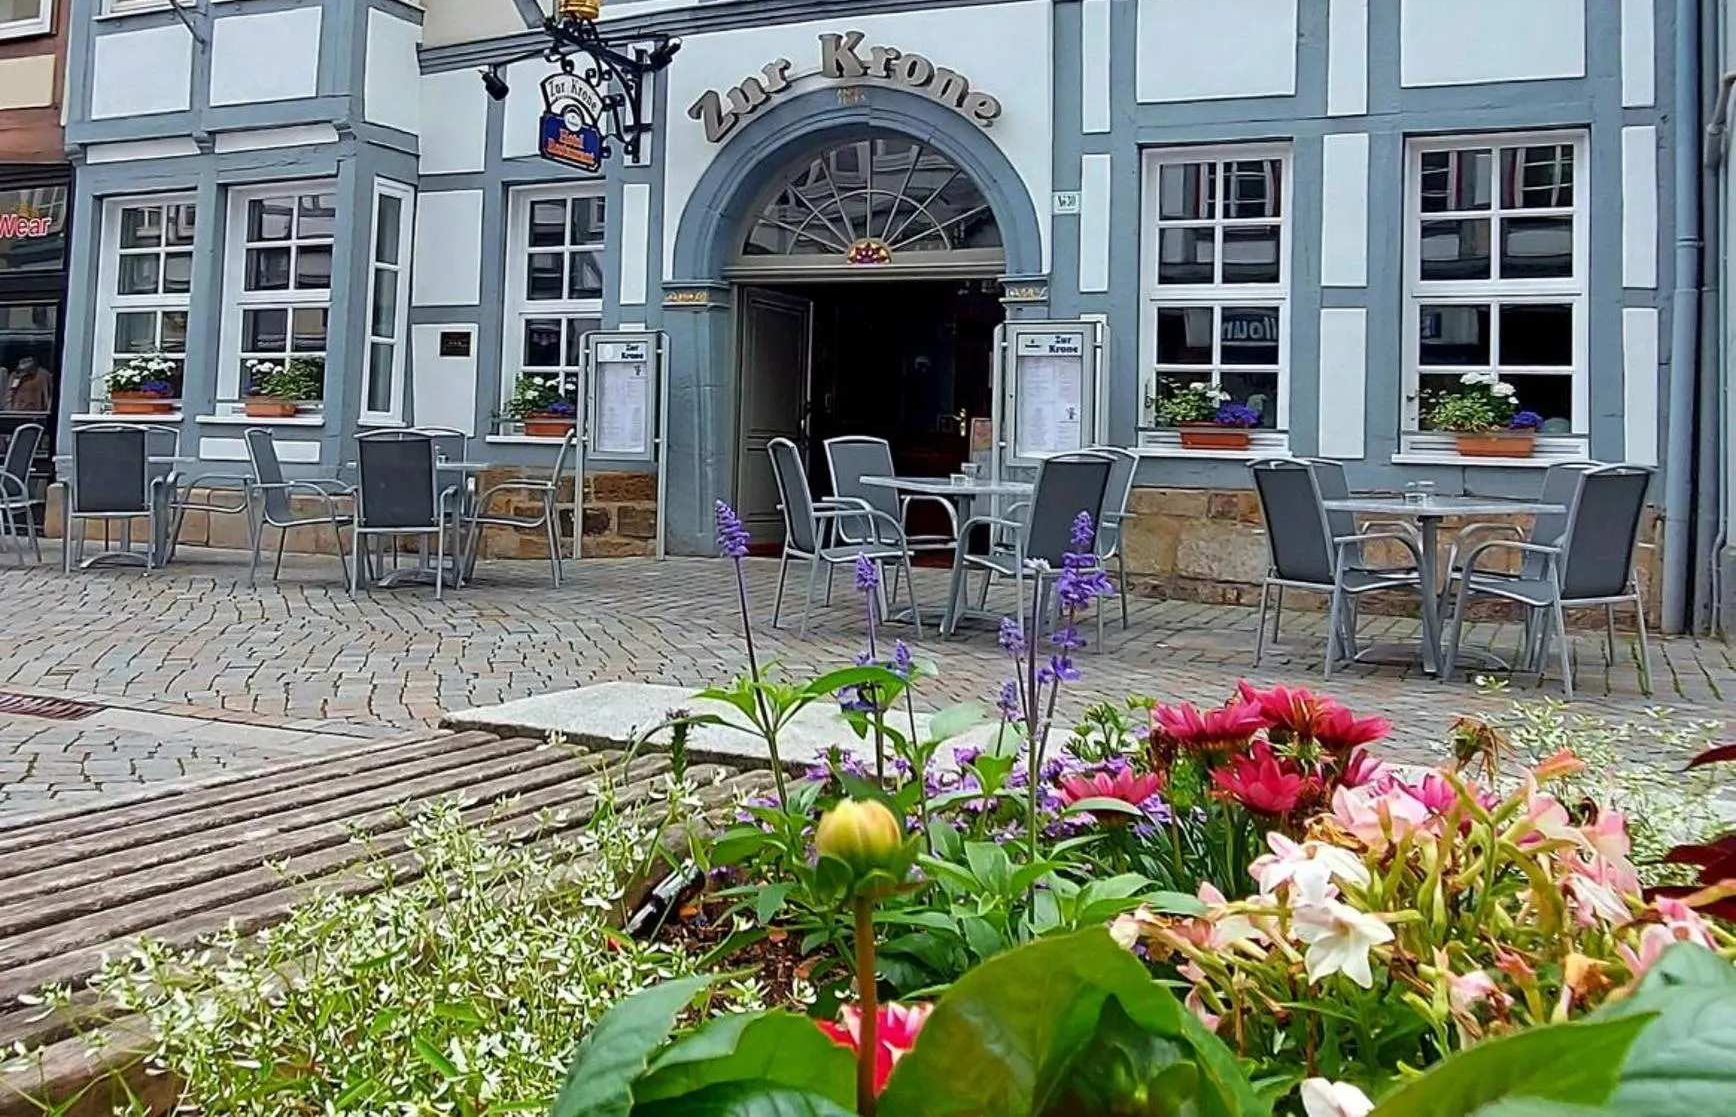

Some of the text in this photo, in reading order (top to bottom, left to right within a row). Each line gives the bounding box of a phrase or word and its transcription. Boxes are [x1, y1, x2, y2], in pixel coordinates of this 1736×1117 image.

[549, 78, 598, 112] Zur Krone
[688, 31, 1002, 143] Zur Krone
[0, 214, 52, 238] Wear
[1049, 344, 1078, 353] Krone
[1055, 336, 1072, 344] Zur
